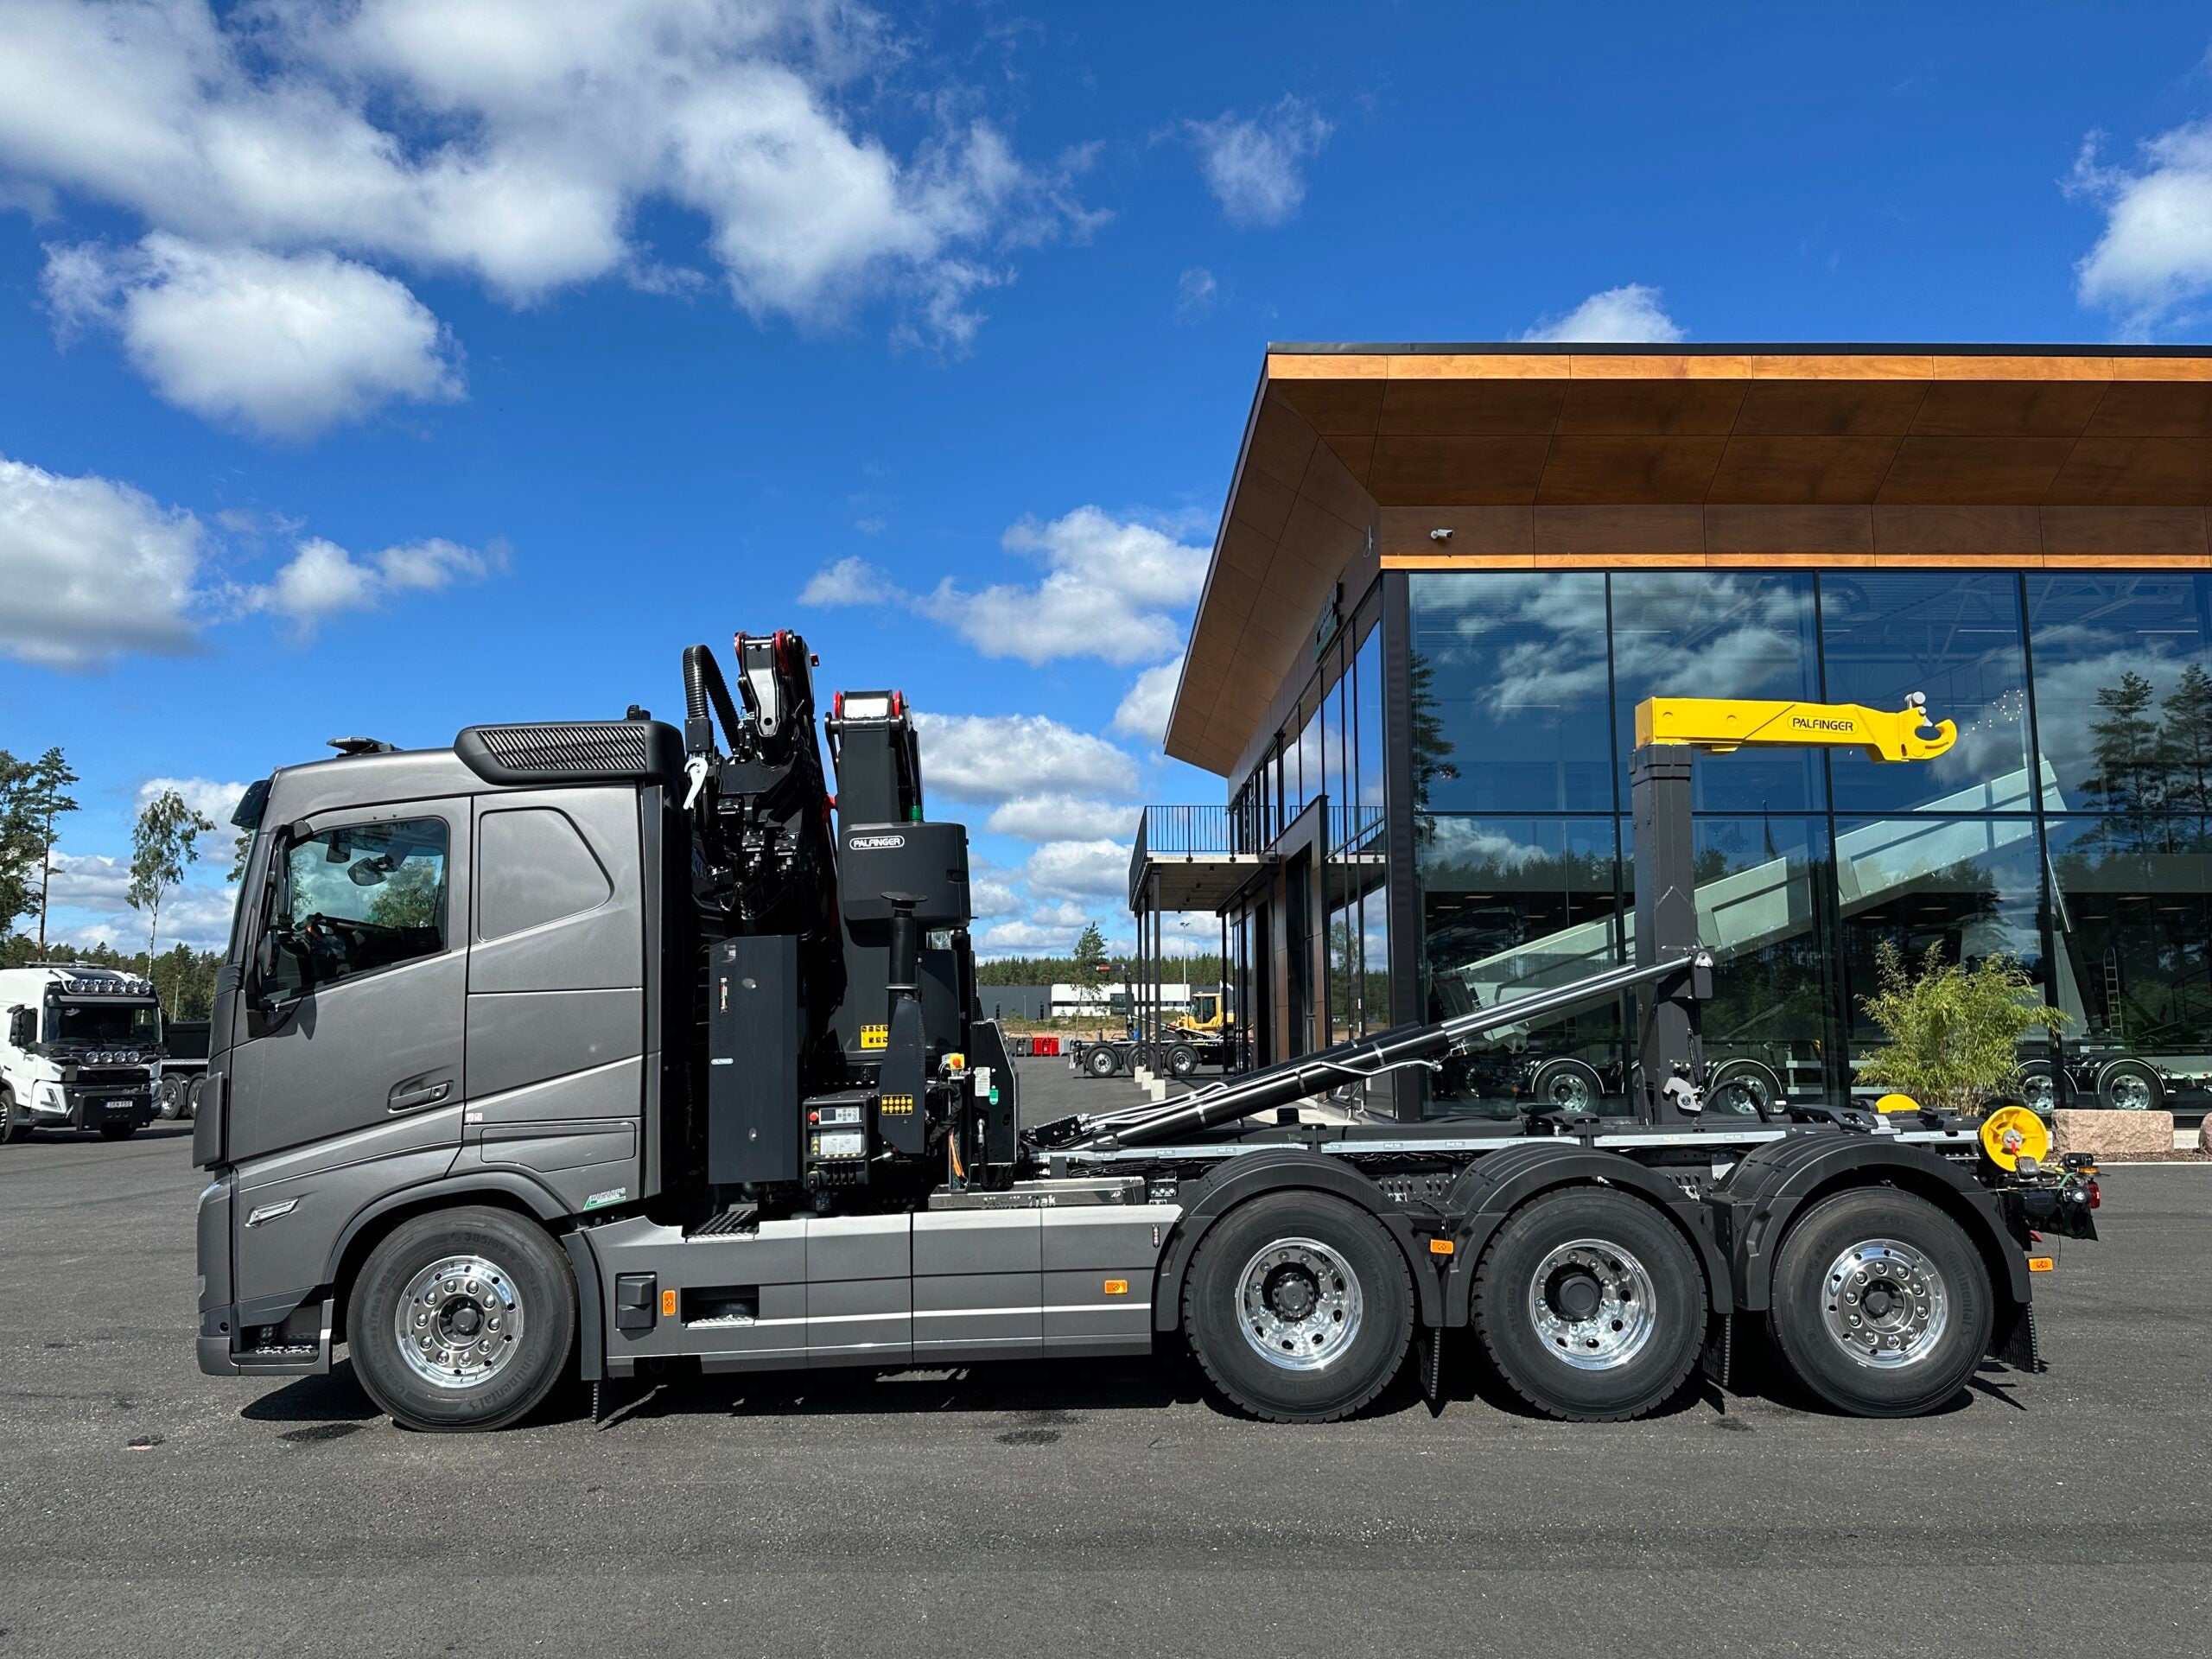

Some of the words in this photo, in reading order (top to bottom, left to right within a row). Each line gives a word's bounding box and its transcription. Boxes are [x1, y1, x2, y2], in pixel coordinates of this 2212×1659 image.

[1792, 718, 1853, 731] PALFINGER
[854, 838, 900, 848] PALFINGER
[464, 1232, 506, 1252] 385/65
[1944, 1251, 1974, 1325] Continental
[1506, 1287, 1521, 1333] 315/80
[480, 1349, 539, 1408] Continental
